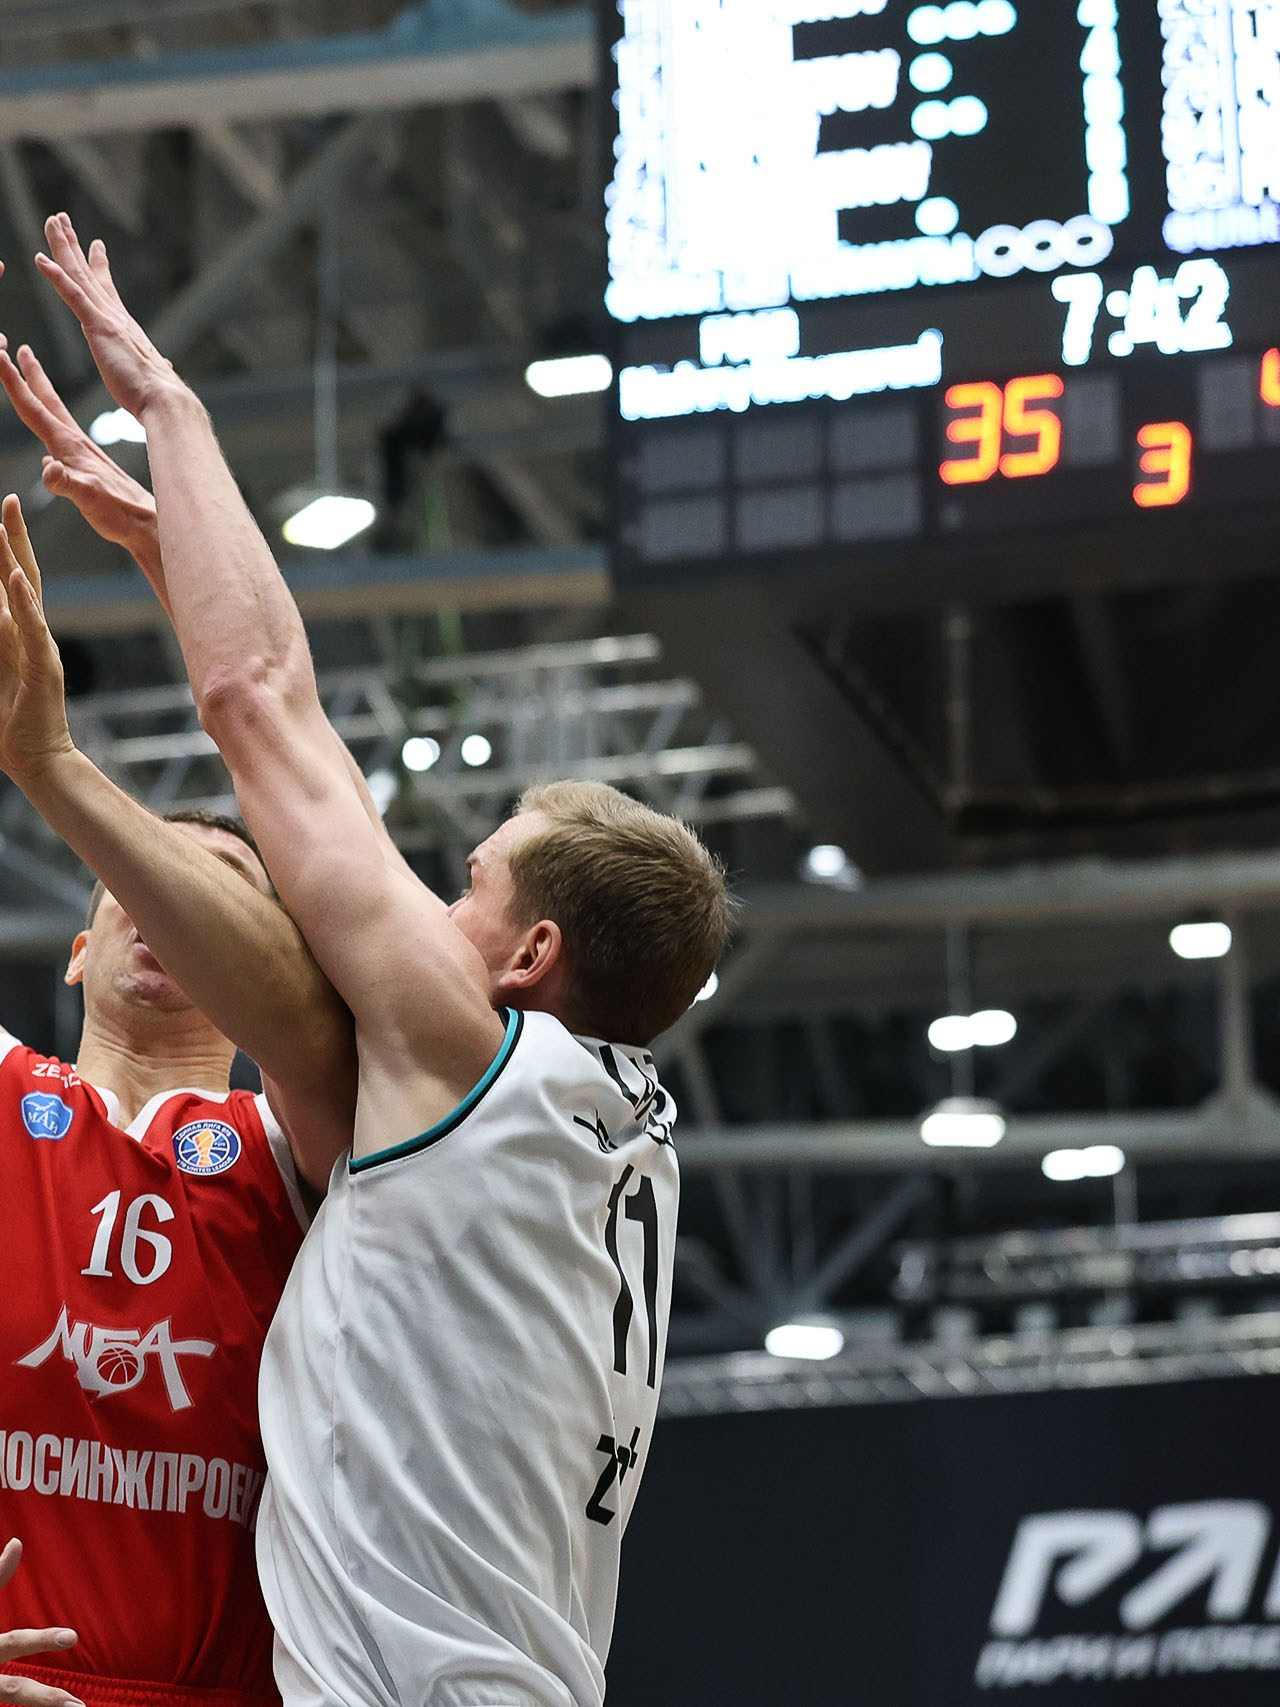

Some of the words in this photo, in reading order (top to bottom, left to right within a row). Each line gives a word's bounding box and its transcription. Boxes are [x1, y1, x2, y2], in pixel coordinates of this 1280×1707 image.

[939, 374, 1064, 485] 35
[1133, 421, 1191, 508] 3
[81, 1189, 175, 1286] 16
[604, 1164, 659, 1390] 11
[988, 1497, 1280, 1638] PA
